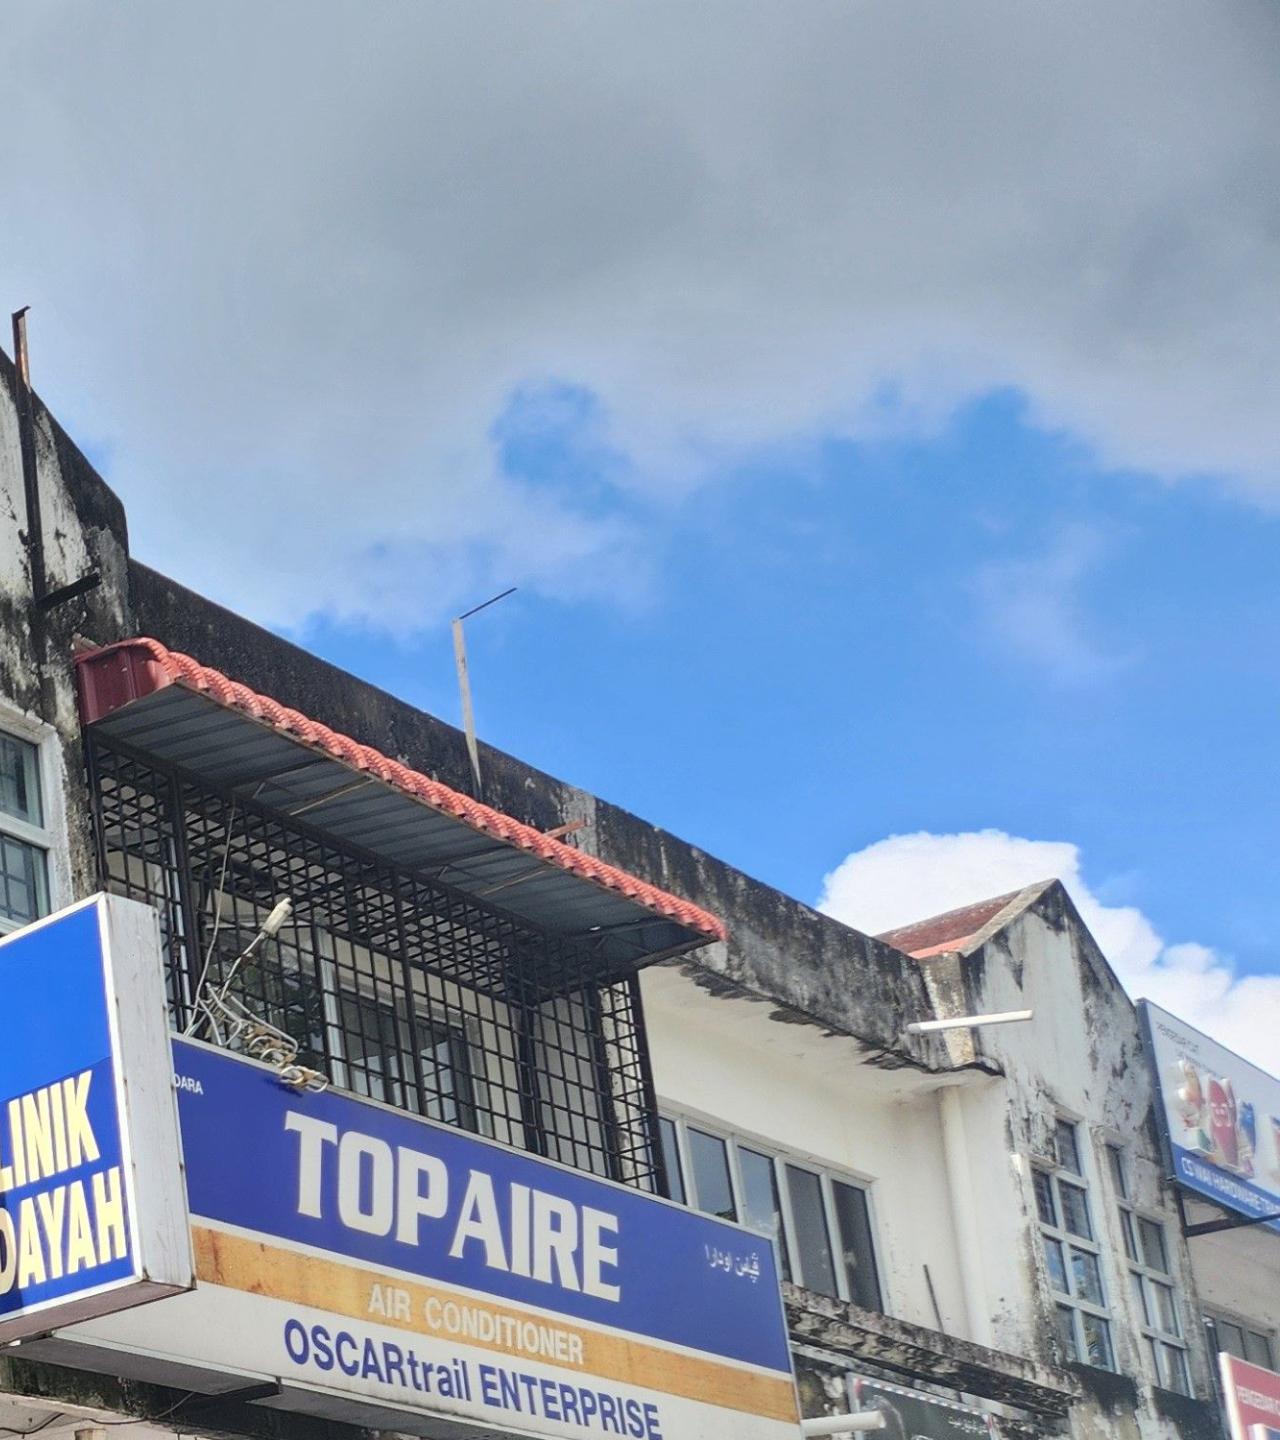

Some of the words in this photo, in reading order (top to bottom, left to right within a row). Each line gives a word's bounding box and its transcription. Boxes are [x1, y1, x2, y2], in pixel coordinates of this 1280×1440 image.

[283, 1109, 622, 1303] TOPAIRE
[283, 1318, 472, 1402] OSCARtrail
[368, 1282, 412, 1323] AIR
[424, 1296, 584, 1366] CONDITIONER
